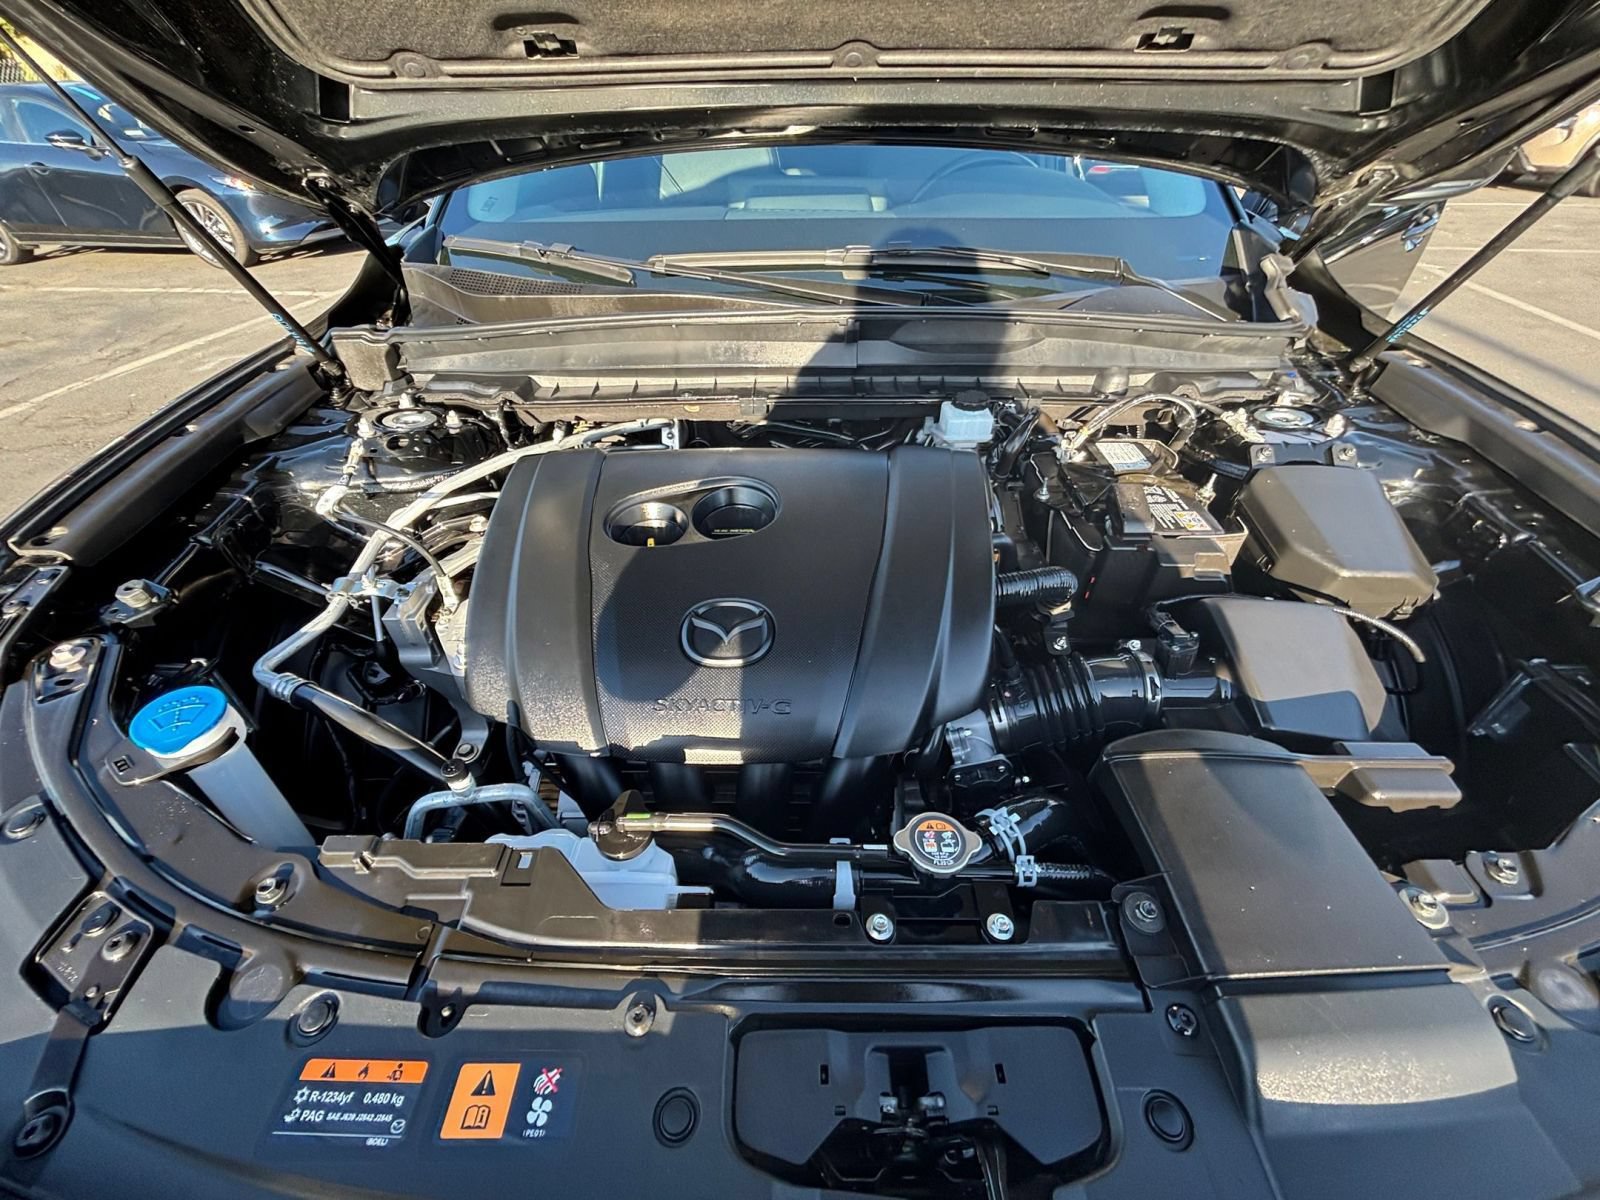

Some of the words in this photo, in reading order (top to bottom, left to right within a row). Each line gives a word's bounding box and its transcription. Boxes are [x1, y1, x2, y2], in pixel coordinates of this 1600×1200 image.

[652, 698, 792, 715] SKYACTIV-G
[309, 1091, 355, 1105] R-1234yf
[363, 1092, 391, 1104] 0.480
[391, 1093, 405, 1107] kg
[299, 1110, 325, 1121] PAG
